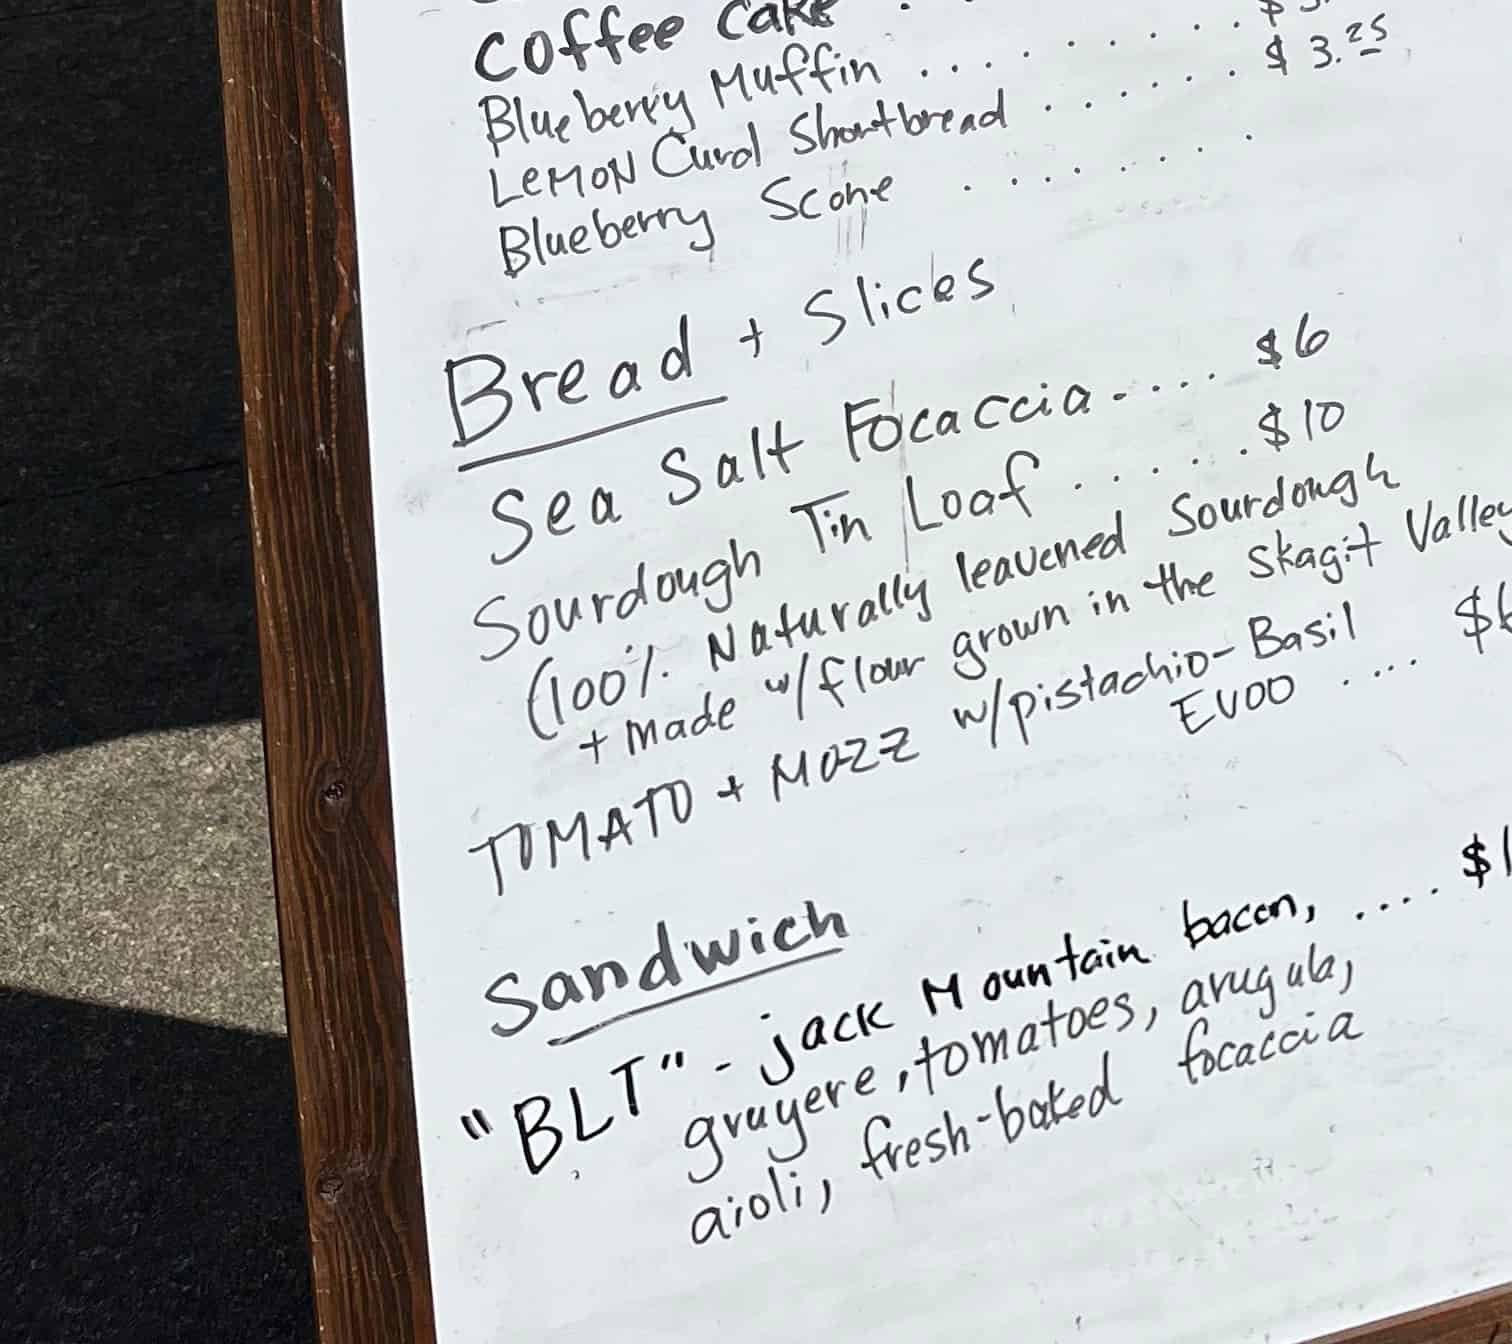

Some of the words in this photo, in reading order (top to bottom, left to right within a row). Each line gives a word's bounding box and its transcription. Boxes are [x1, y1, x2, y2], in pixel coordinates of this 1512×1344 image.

[475, 5, 684, 82] Coffee
[478, 87, 696, 158] Blueberry
[709, 42, 882, 109] Muffin
[652, 121, 762, 178] Curd
[790, 88, 1007, 155] Shortbread
[498, 207, 716, 278] Blueberry
[761, 175, 894, 221] Scone
[444, 313, 692, 448] Bread
[739, 318, 764, 359] +
[803, 258, 995, 346] Slices
[490, 488, 622, 566] Sea
[660, 419, 805, 506] Salt
[844, 382, 1091, 463] Focaccia
[1256, 312, 1330, 370] $6
[473, 538, 761, 662] Sourdough
[790, 490, 872, 553] Tin
[905, 450, 1040, 532] Loaf
[1258, 399, 1345, 452] $10
[708, 573, 931, 671] Naturally
[956, 510, 1127, 594] leavened
[579, 729, 608, 765] +
[952, 603, 1071, 681] grown
[1088, 585, 1131, 618] in
[1144, 562, 1216, 606] the
[468, 779, 692, 897] TOMATO
[717, 775, 745, 803] +
[484, 900, 850, 1038] Sandwich
[922, 933, 1151, 1017] Mountain
[691, 1165, 833, 1246] aioli,
[1178, 1007, 1364, 1086] focaccia
